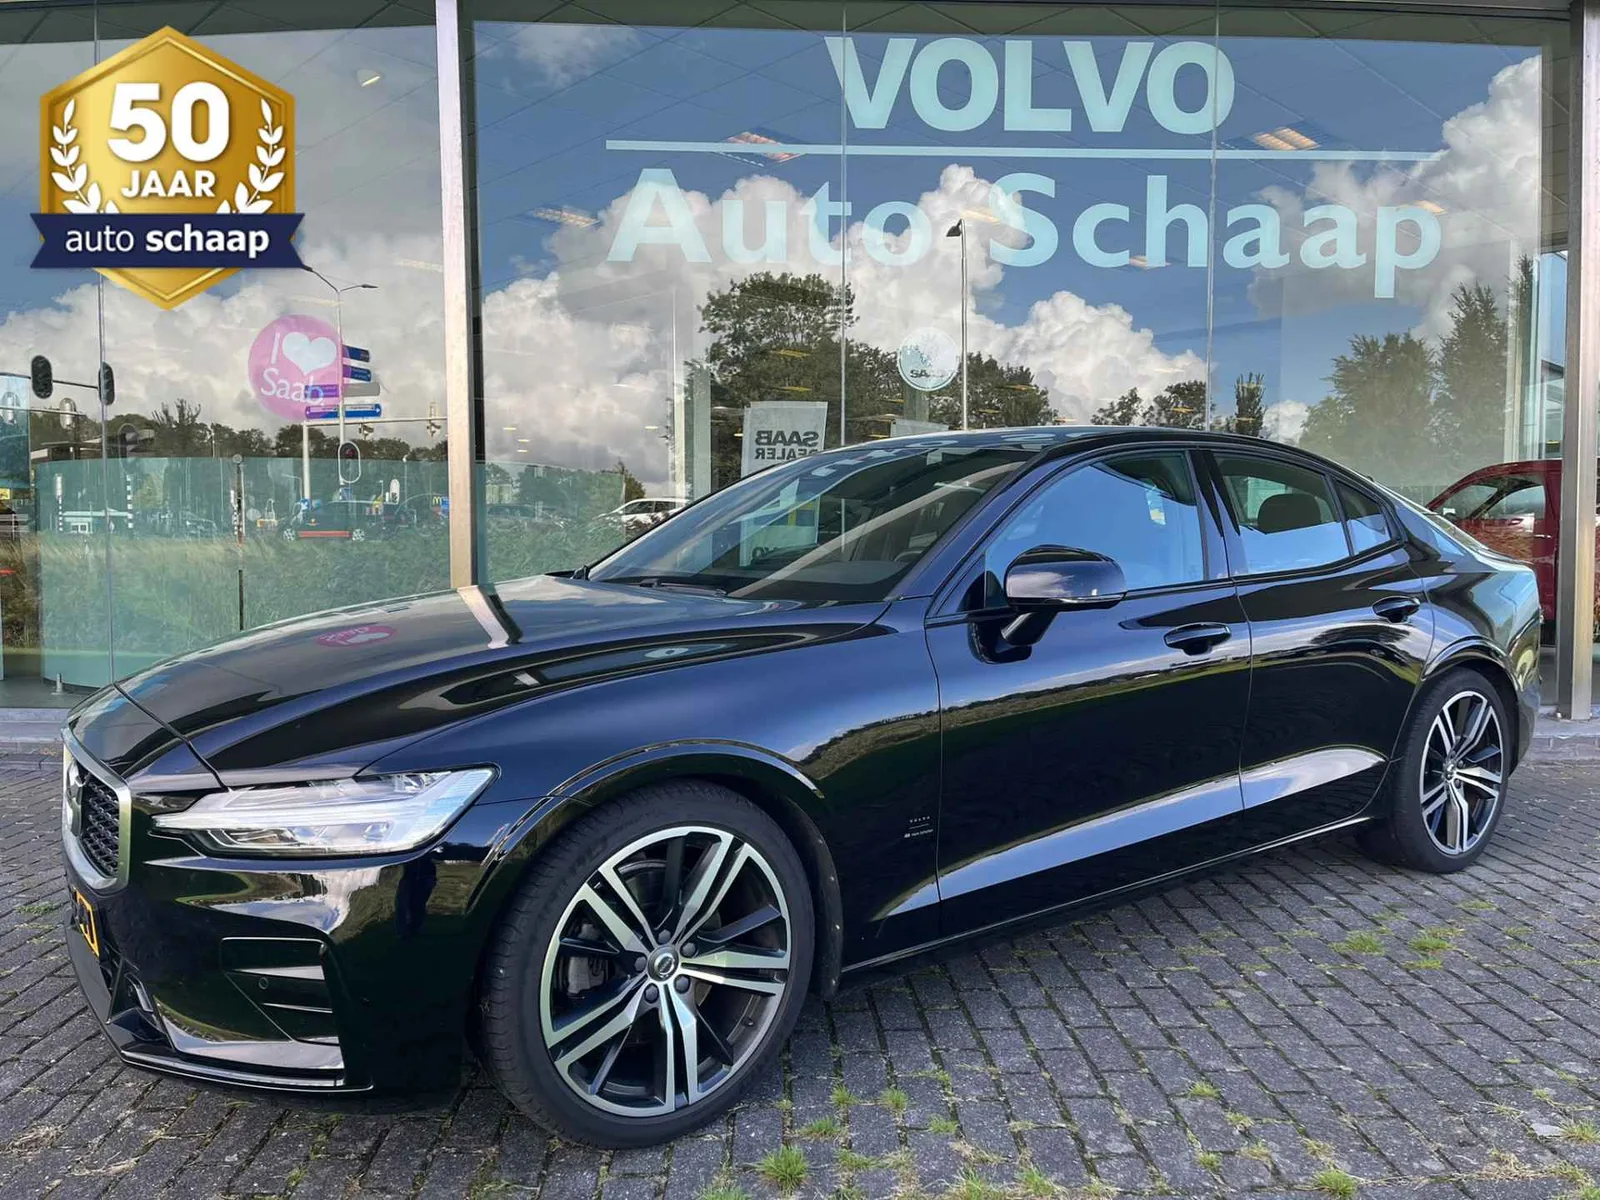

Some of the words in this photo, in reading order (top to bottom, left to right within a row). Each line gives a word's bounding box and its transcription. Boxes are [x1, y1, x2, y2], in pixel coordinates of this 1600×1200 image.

[824, 37, 1235, 134] VOLVO
[607, 168, 932, 266] Auto
[989, 172, 1442, 298] Schaap
